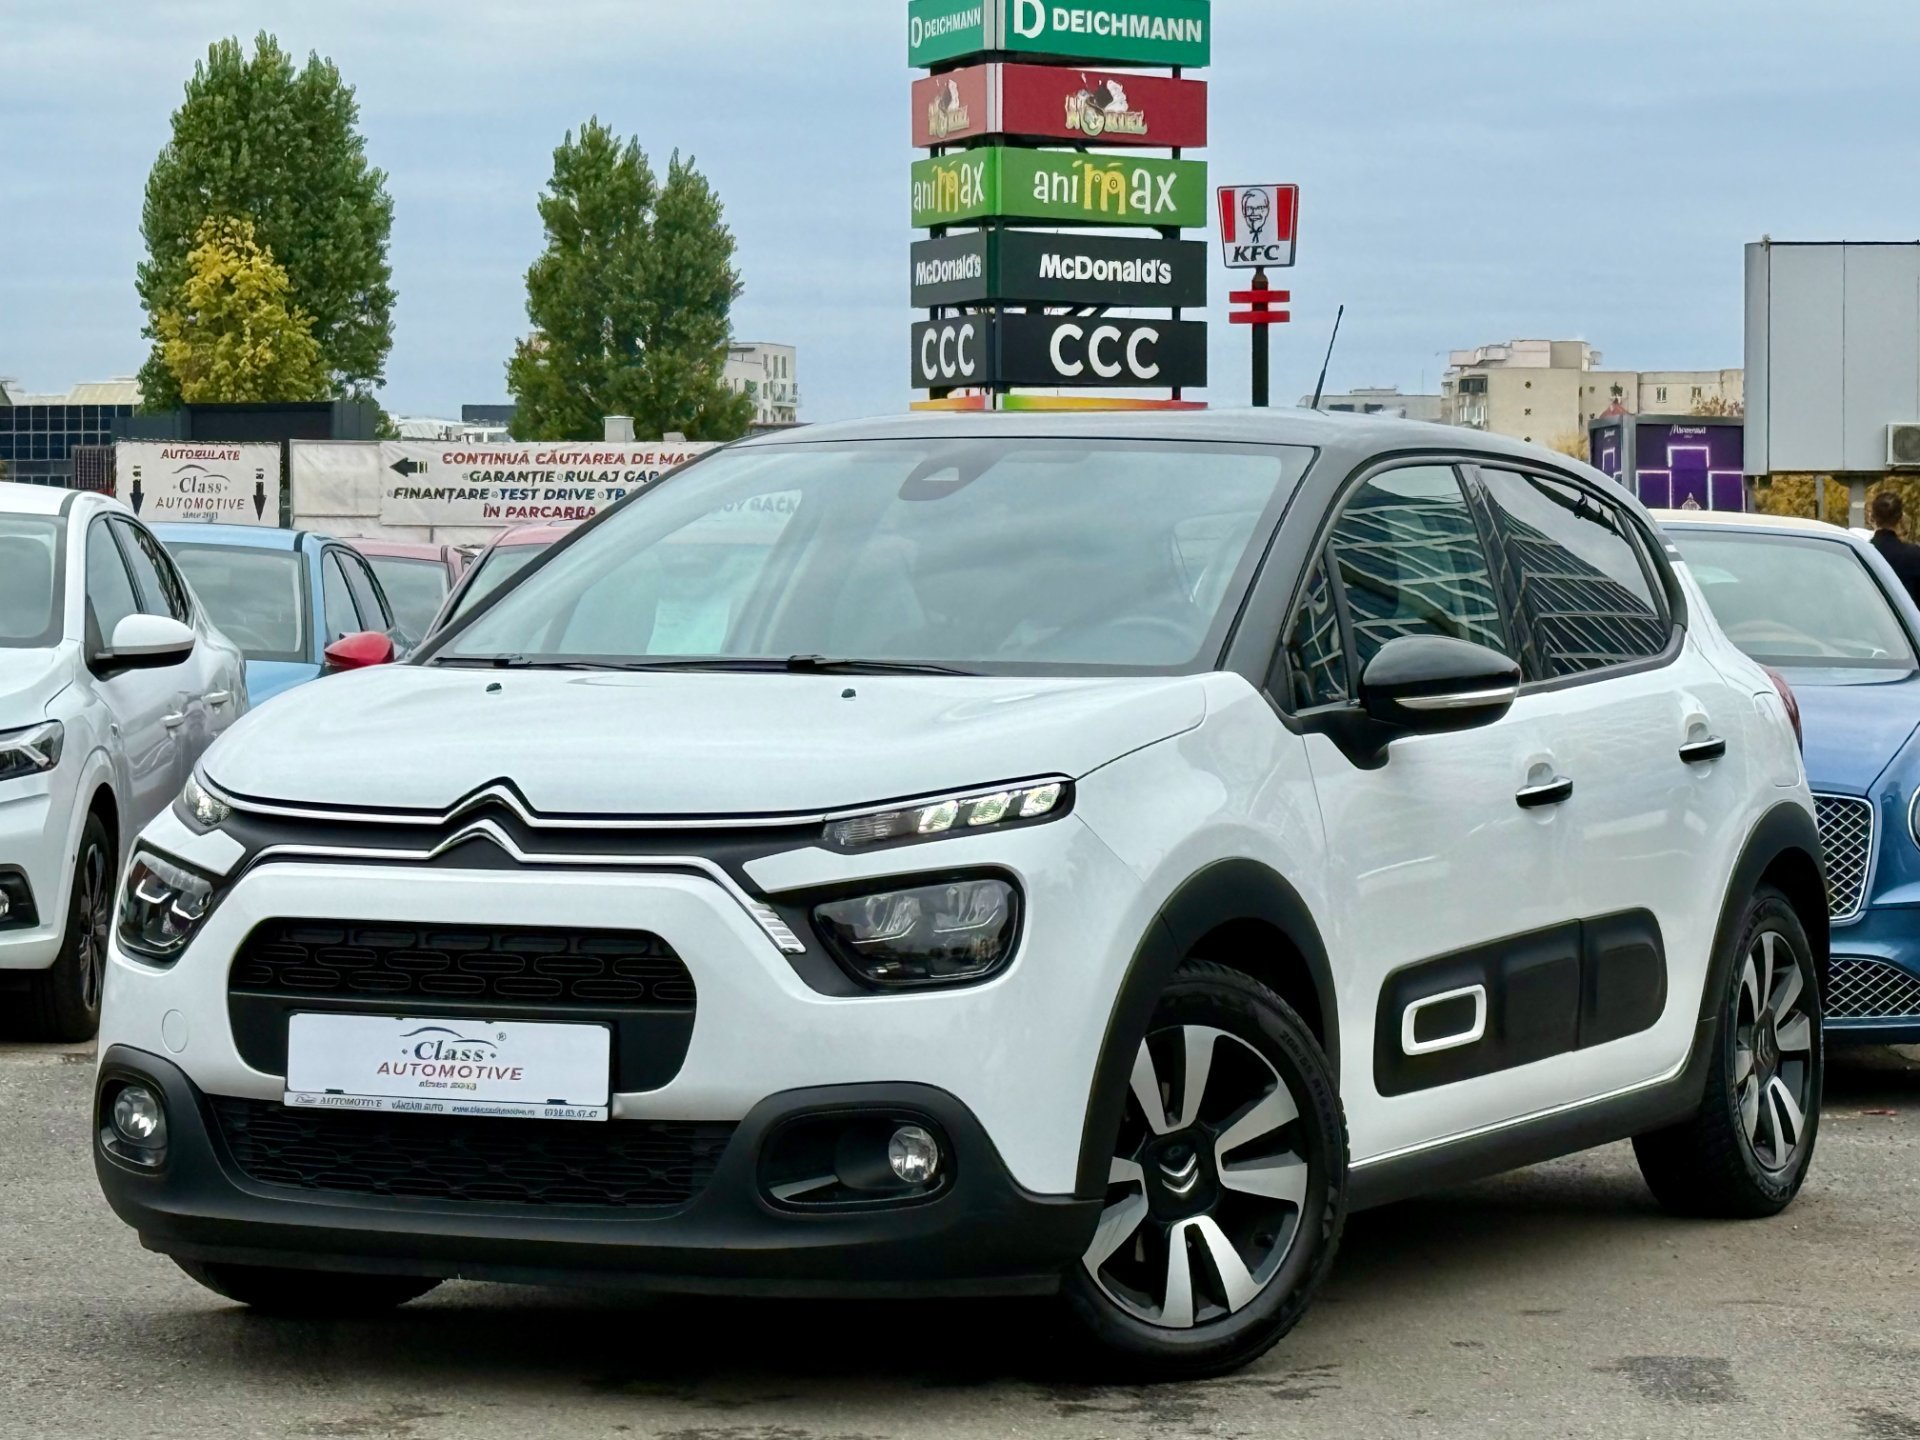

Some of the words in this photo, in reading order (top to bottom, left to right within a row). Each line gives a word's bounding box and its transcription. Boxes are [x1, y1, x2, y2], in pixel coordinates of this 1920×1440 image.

[925, 8, 981, 38] DEICHMANN
[1053, 8, 1203, 43] DEICHMANN
[913, 161, 985, 215] animax
[1033, 160, 1178, 215] animax
[1232, 244, 1281, 263] KFC
[916, 253, 982, 287] McDonald's
[1039, 254, 1172, 285] McDonald's
[921, 324, 975, 381] CCC
[1049, 323, 1161, 380] CCC
[160, 448, 240, 460] AUTORULATE
[442, 450, 530, 465] CONTINUĂ
[535, 449, 626, 465] CĂUTAREA
[631, 452, 655, 464] DE
[179, 475, 222, 493] Class
[564, 470, 619, 482] RULAJ
[155, 496, 246, 510] AUTOMOTIVE
[499, 488, 540, 501] TEST
[543, 488, 596, 501] DRIVE
[483, 503, 501, 518] ÎN
[414, 1039, 485, 1062] Class
[377, 1061, 525, 1081] AUTOMOTIVE
[320, 1096, 383, 1108] AUTOMOTIVE
